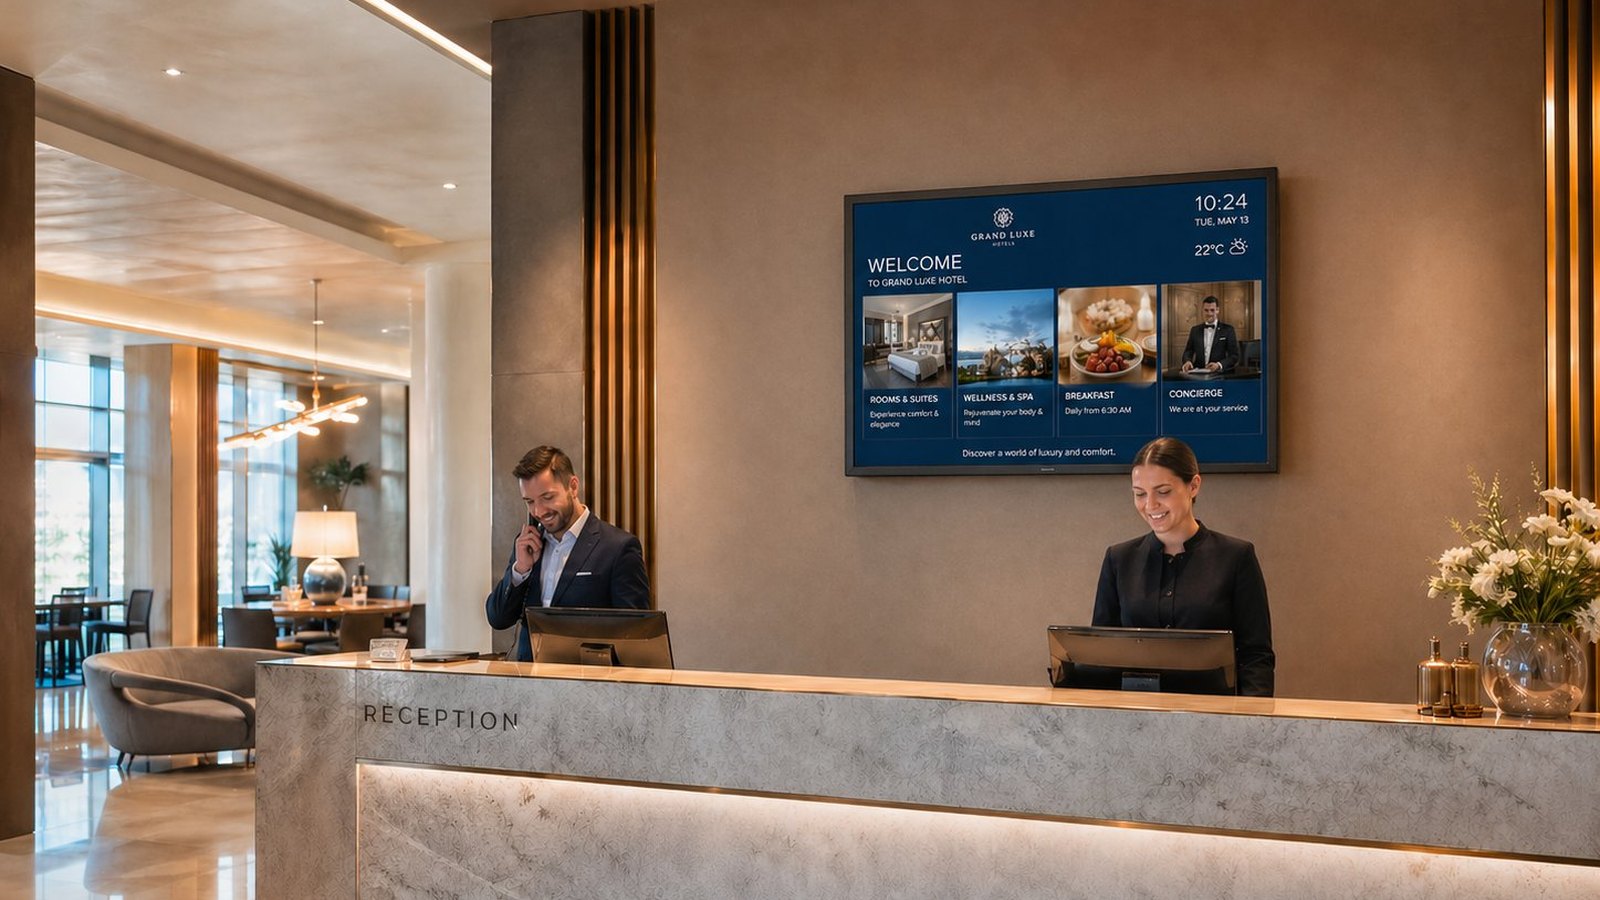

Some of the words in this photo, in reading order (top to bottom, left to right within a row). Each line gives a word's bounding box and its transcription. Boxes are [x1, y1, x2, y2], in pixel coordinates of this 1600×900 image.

[1195, 193, 1248, 211] 10:24
[1217, 216, 1238, 225] MAY
[1240, 215, 1249, 224] 13
[971, 231, 1006, 241] GRAND
[1010, 229, 1036, 239] LUXE
[1194, 243, 1225, 256] 22°C
[867, 254, 962, 273] WELCOME
[868, 279, 880, 287] TO
[881, 278, 913, 287] GRAND
[914, 277, 937, 286] LUXE
[938, 275, 968, 285] HOTEL
[963, 393, 1008, 402] WELLNESS
[1008, 393, 1015, 401] &
[1016, 392, 1034, 401] SPA
[1065, 391, 1115, 400] BREAKFAST
[1169, 388, 1223, 398] CONCIERGE
[870, 395, 901, 404] ROOMS
[902, 395, 908, 403] &
[909, 394, 939, 403] SUITES
[933, 409, 940, 417] &
[1002, 409, 1018, 417] your
[1018, 408, 1037, 417] body
[1037, 407, 1044, 415] &
[1065, 406, 1083, 416] Daily
[1083, 406, 1100, 414] from
[1119, 406, 1132, 414] AM
[1195, 405, 1204, 413] at
[1204, 406, 1221, 414] your
[1222, 404, 1249, 412] service
[962, 448, 996, 458] Discover
[1004, 448, 1027, 457] world
[1028, 448, 1037, 457] of
[1037, 448, 1063, 458] luxury
[1064, 448, 1080, 457] and
[1081, 447, 1116, 457] comfort.
[364, 704, 518, 731] RECEPTION
